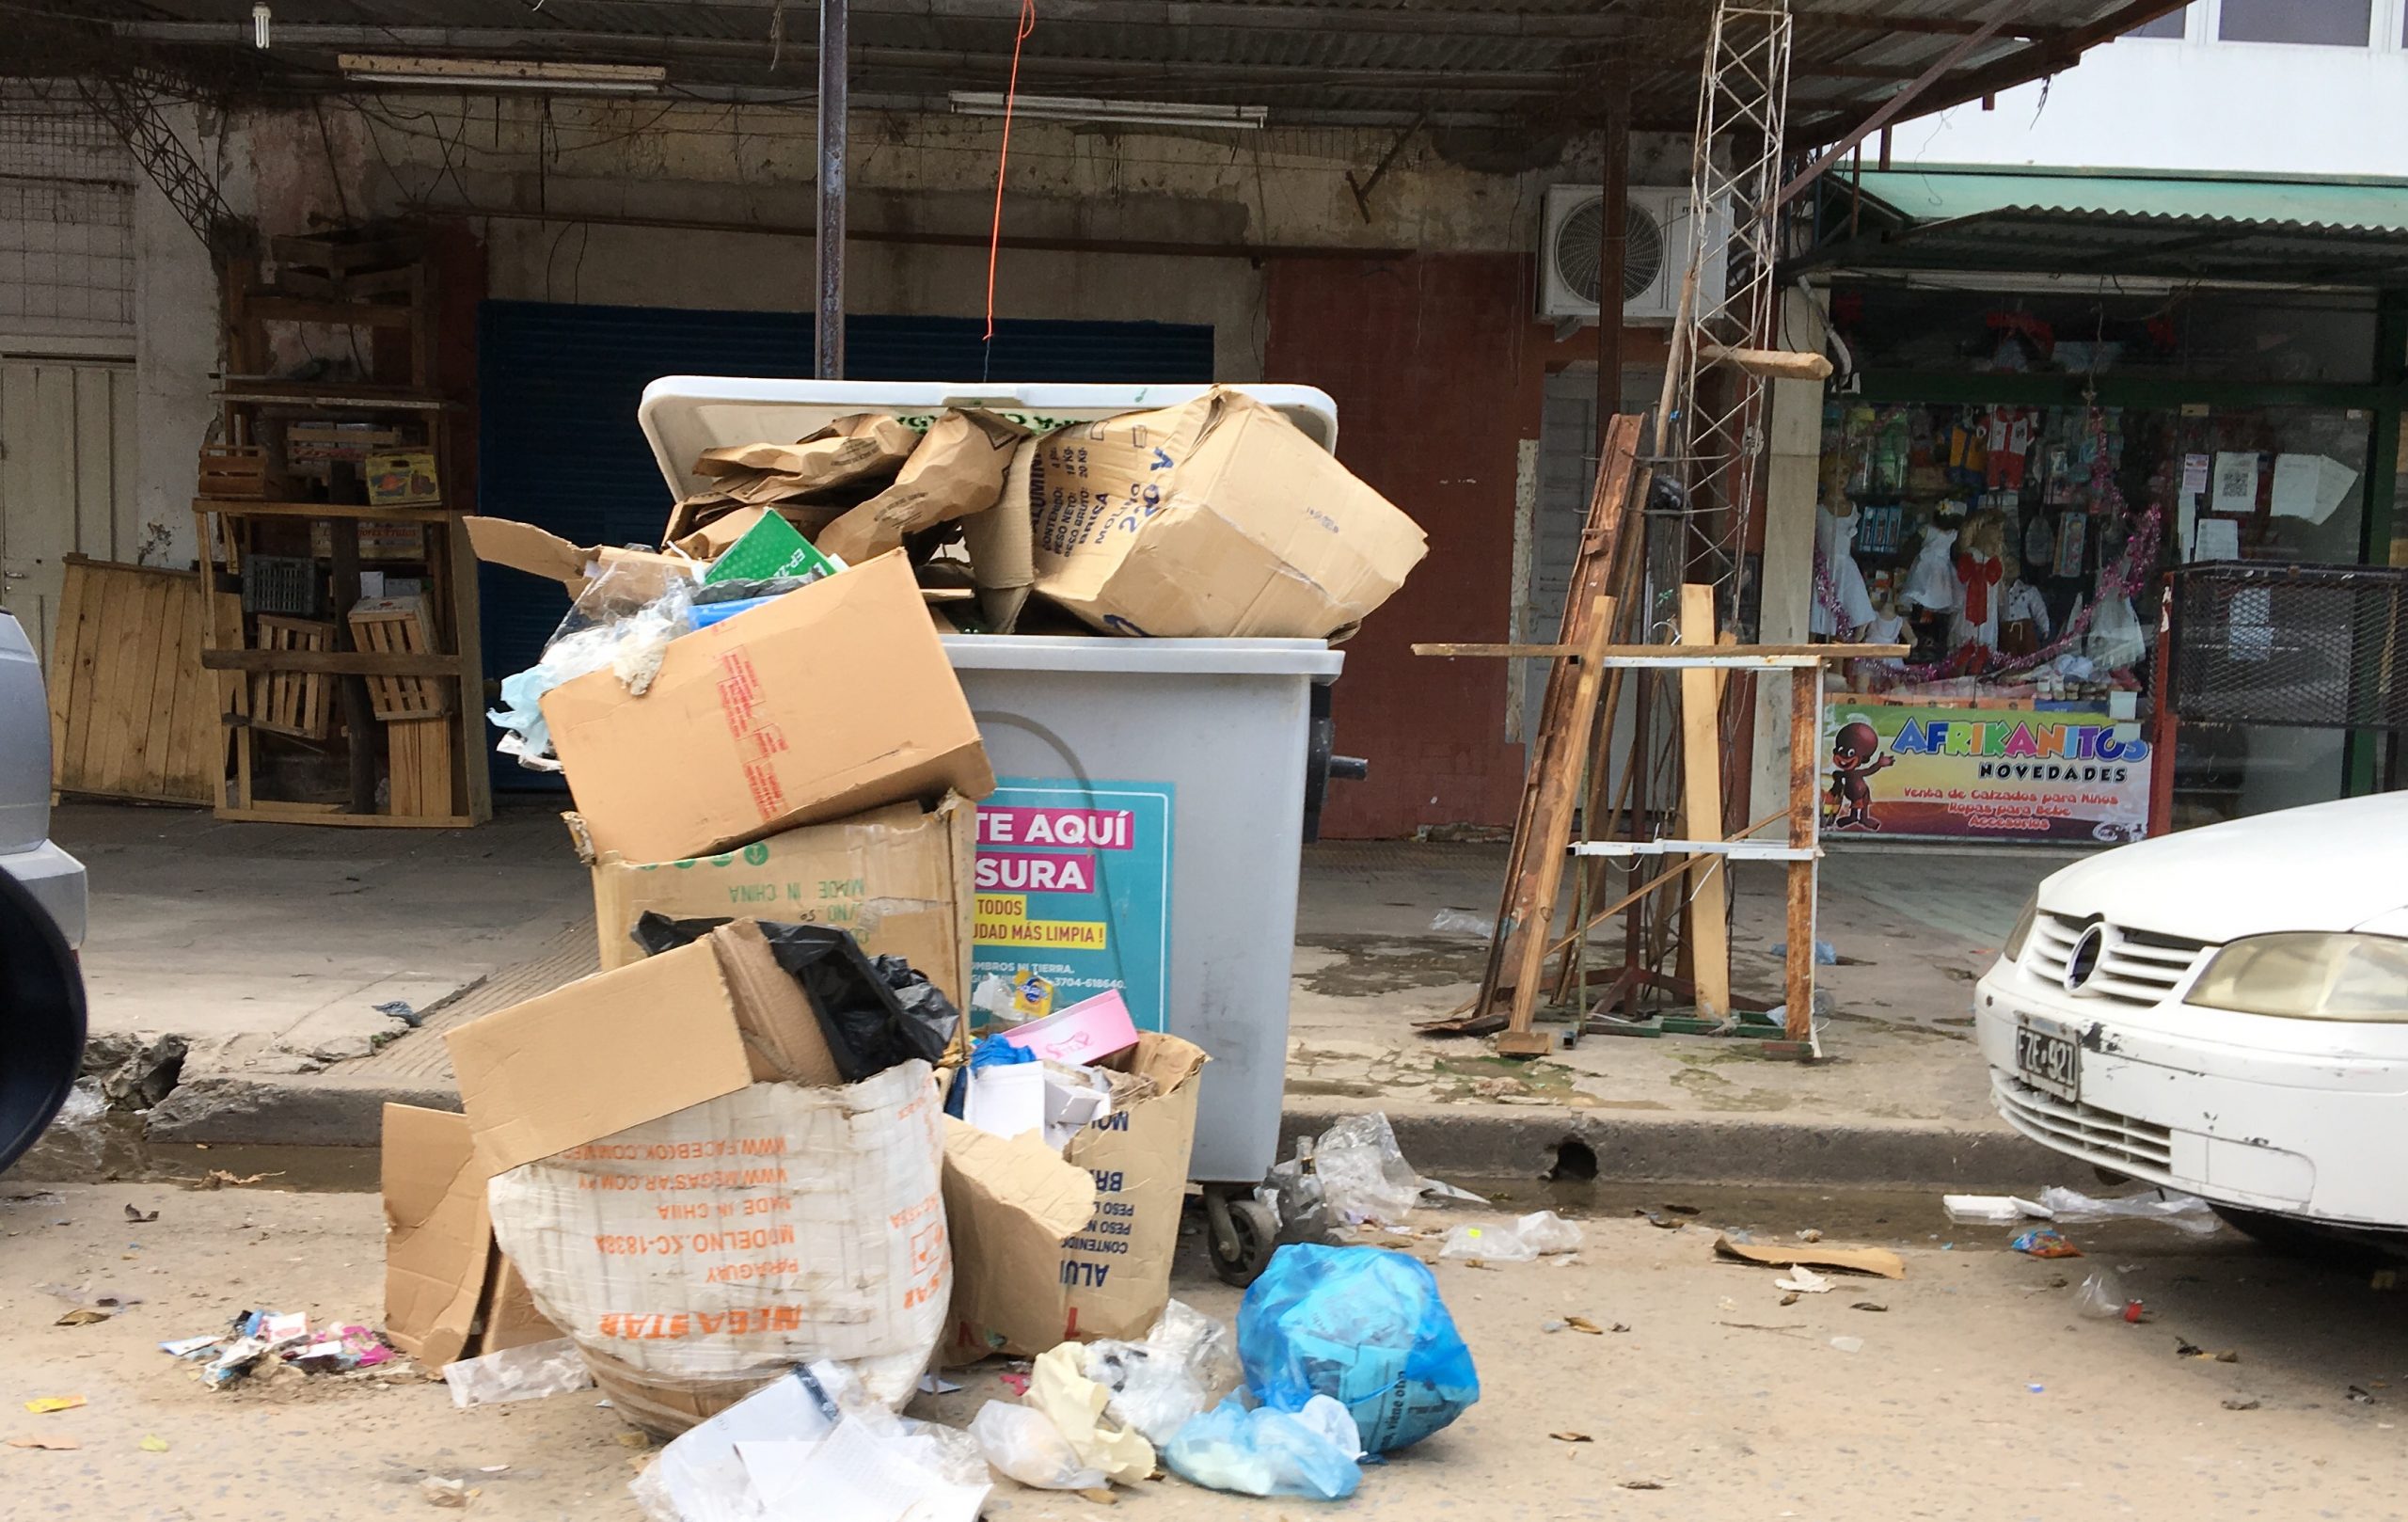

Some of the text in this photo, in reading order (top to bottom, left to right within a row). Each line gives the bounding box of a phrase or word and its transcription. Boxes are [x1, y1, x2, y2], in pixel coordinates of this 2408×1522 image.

[1150, 447, 1174, 471] V
[1979, 762, 2128, 783] NOVEDADES
[1904, 786, 1943, 800] Venta
[1948, 788, 1967, 799] de
[1971, 789, 2037, 802] Calzados
[2041, 793, 2077, 804] para
[1024, 810, 1129, 846] AQUÍ
[975, 858, 1086, 890] SURA
[728, 879, 864, 903] MADE IN CHINA
[977, 898, 1022, 916] TODOS
[1011, 921, 1042, 942] MÁS
[1046, 925, 1095, 943] LIMPIA
[1090, 1170, 1123, 1192] BR
[1103, 1201, 1134, 1216] PESO
[1101, 1221, 1132, 1235] PESO
[1059, 1260, 1110, 1287] ALU
